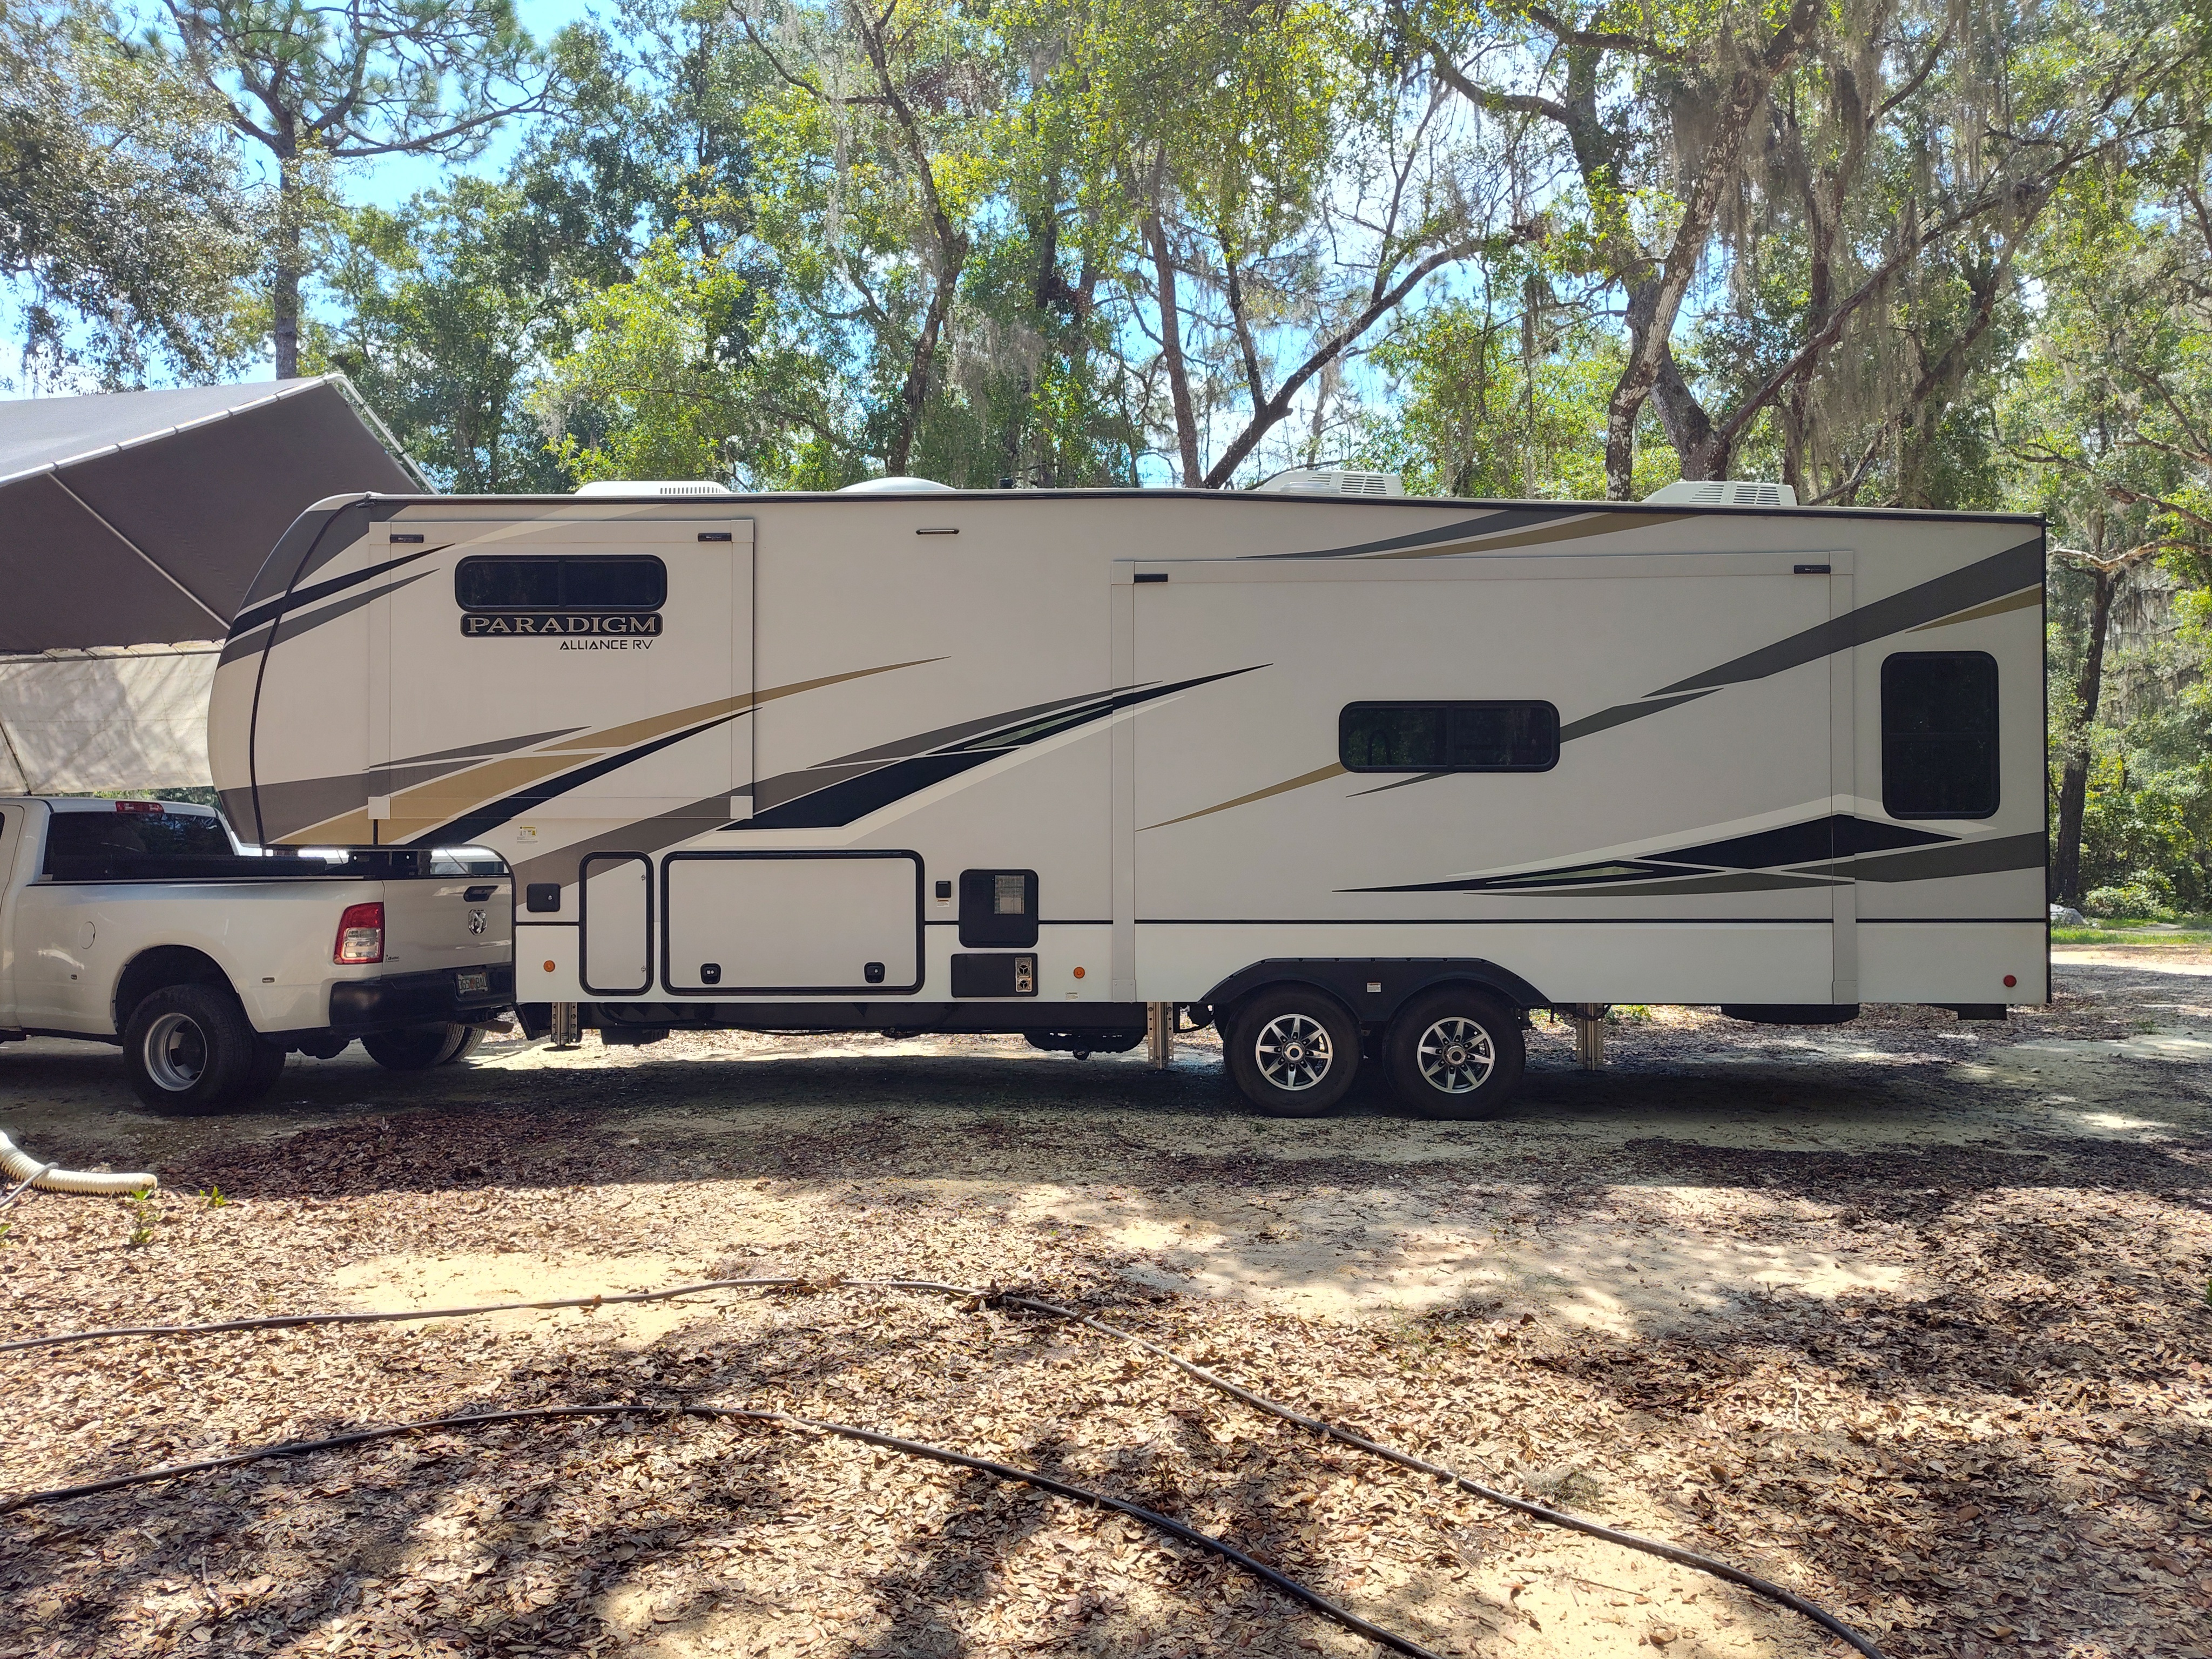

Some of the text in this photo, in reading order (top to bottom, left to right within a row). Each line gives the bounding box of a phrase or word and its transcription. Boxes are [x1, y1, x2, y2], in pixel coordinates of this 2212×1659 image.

[467, 617, 656, 633] PARADIGM
[559, 639, 653, 651] ALLIANCE RV
